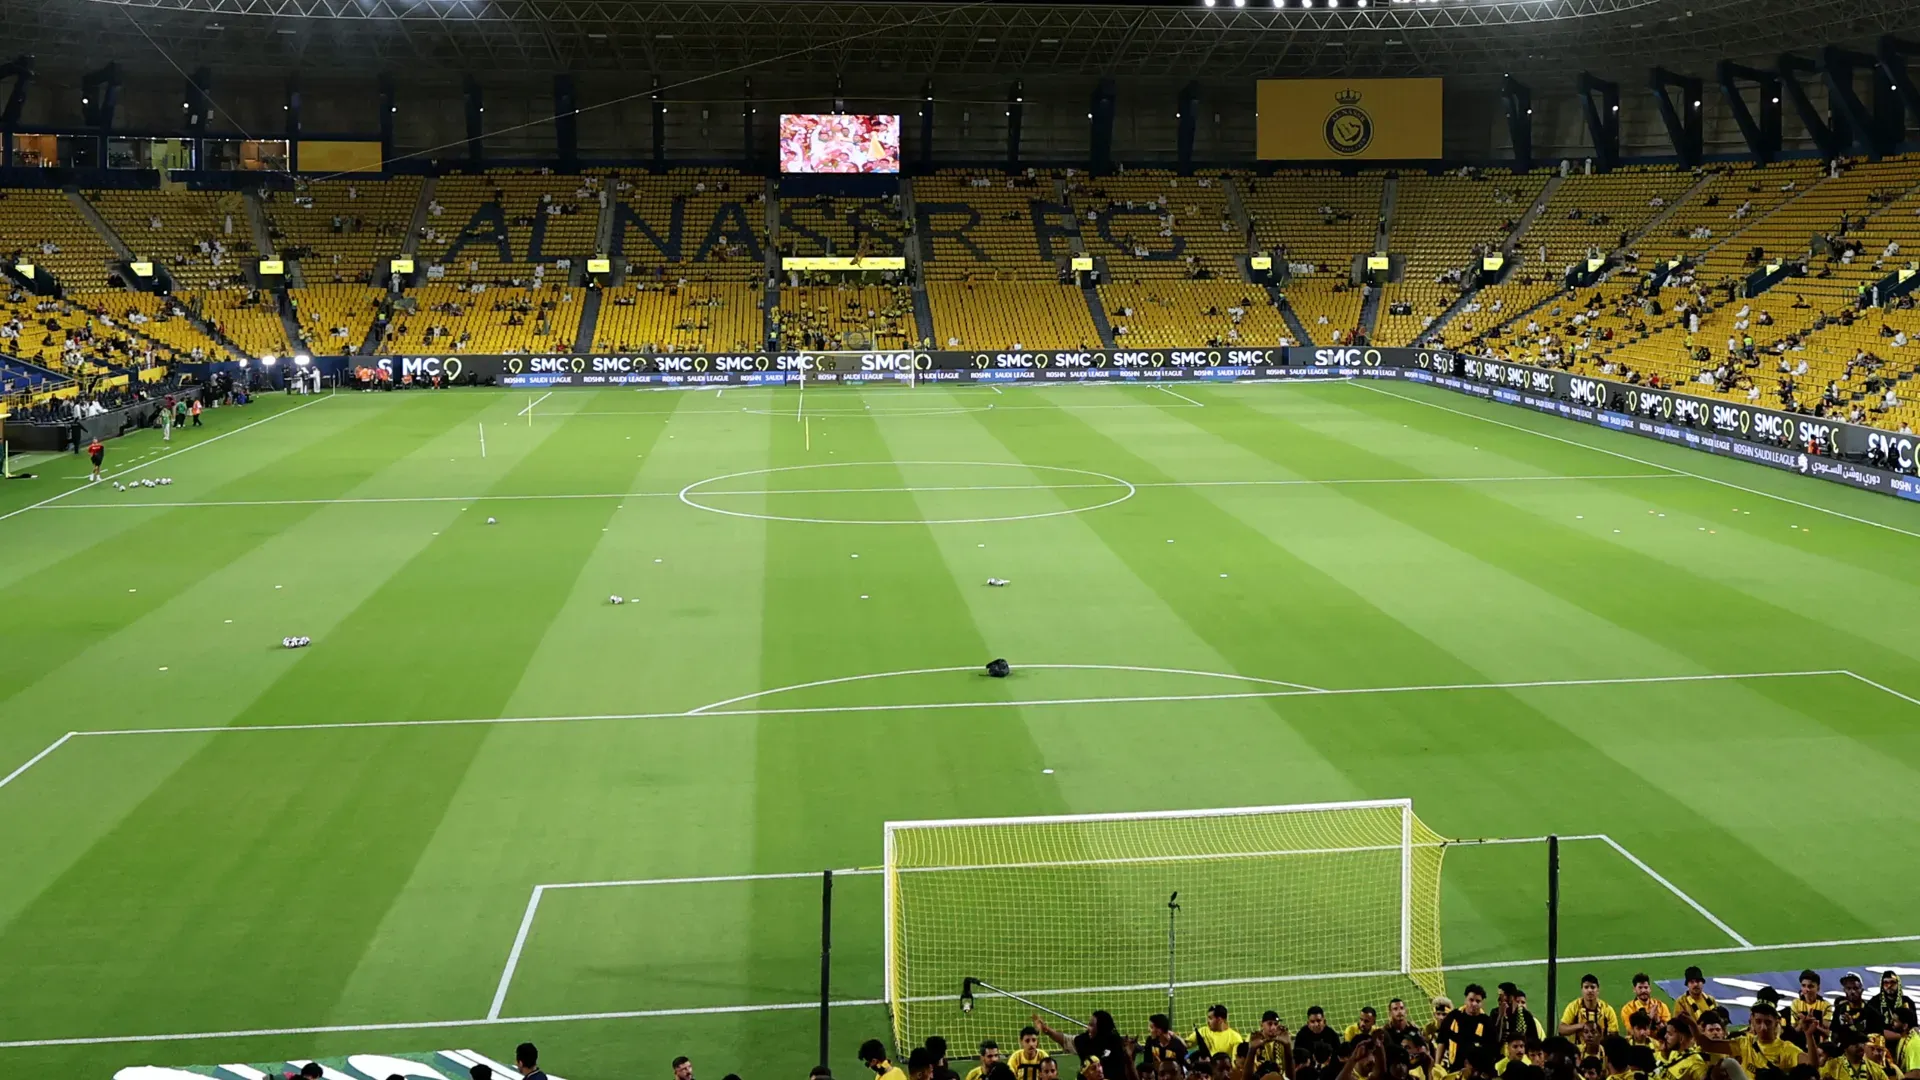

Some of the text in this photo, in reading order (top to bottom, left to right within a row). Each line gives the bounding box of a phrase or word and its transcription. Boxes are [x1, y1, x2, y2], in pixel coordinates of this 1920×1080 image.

[531, 358, 568, 371] SMC
[592, 357, 630, 371] SMC
[657, 357, 692, 371] SMC
[716, 357, 753, 370] SMC
[776, 356, 813, 370] SMC
[861, 354, 911, 370] SMC
[997, 354, 1032, 367] SMC
[1055, 353, 1090, 366] SMC
[1113, 352, 1148, 365] SMC
[1171, 351, 1206, 364] SMC
[1228, 351, 1263, 364] SMC
[1315, 350, 1361, 366] SMC
[1484, 362, 1499, 379] SMC
[1507, 366, 1523, 383] SMC
[549, 376, 572, 384] LEAGUE
[1532, 371, 1549, 389] SMC
[1570, 377, 1595, 402] SMC
[1640, 392, 1662, 412] SMC
[1675, 398, 1699, 419] SMC
[1713, 405, 1739, 427] SMC
[1754, 412, 1782, 436] SMC
[1654, 425, 1665, 434] SAUDI
[1665, 428, 1680, 439] LEAGUE
[1701, 437, 1713, 447] SAUDI
[1714, 440, 1730, 450] LEAGUE
[1733, 443, 1795, 467] ROSHN SAUDI LEAGUE
[1811, 461, 1880, 486] دوري روشن السعودي
[1891, 479, 1911, 492] ROSHN
